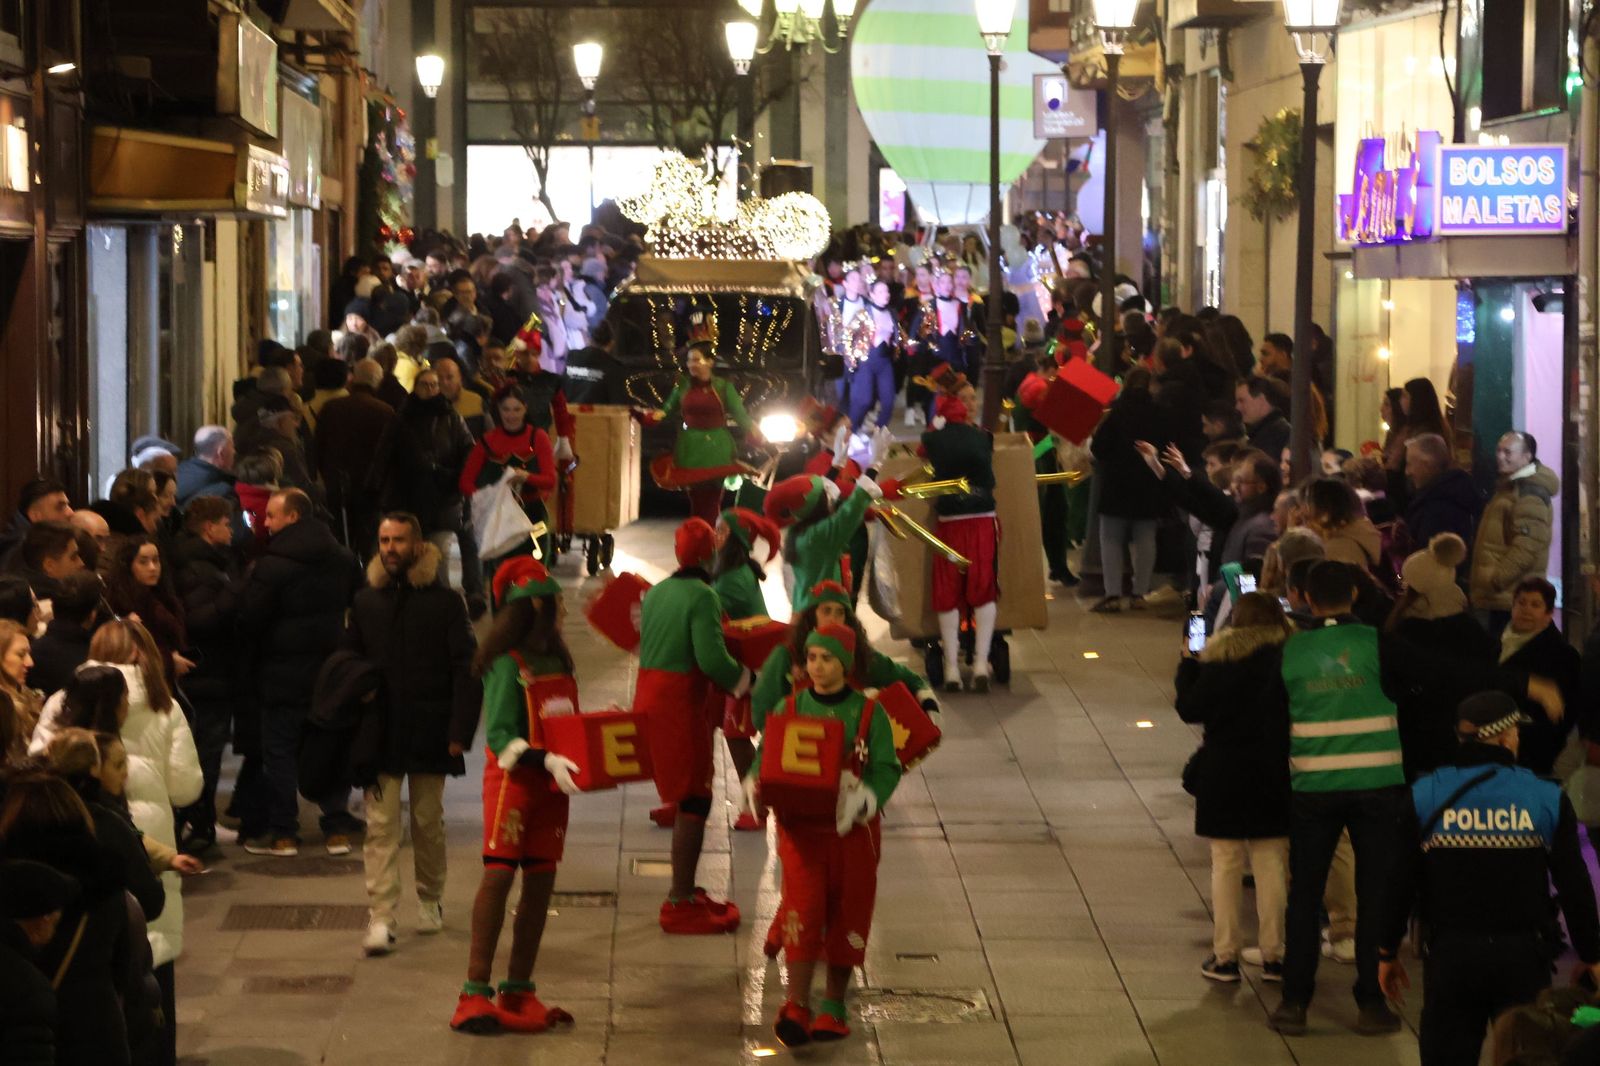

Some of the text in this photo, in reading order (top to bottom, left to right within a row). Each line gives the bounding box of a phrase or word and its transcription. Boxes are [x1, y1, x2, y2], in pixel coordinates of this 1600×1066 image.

[1449, 156, 1555, 186] BOLSOS
[1442, 194, 1562, 225] MALETAS
[602, 721, 642, 777] E
[780, 721, 825, 776] E
[1443, 803, 1535, 831] POLICÍA
